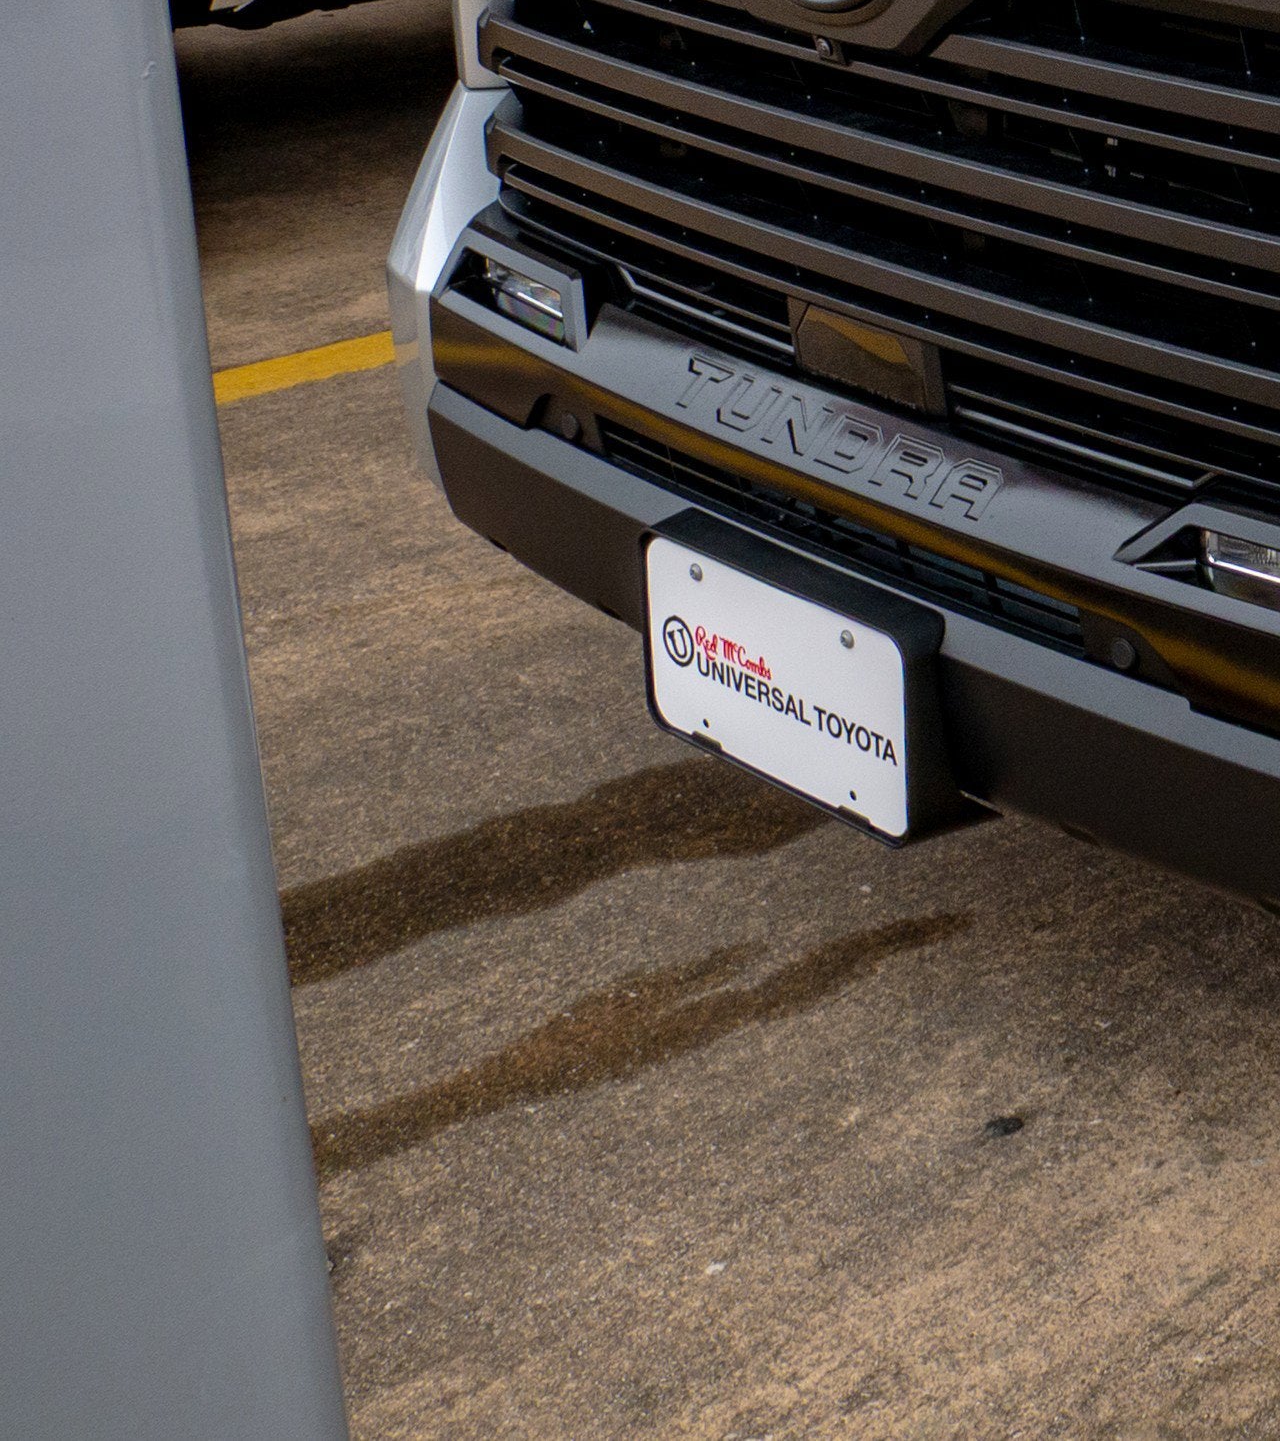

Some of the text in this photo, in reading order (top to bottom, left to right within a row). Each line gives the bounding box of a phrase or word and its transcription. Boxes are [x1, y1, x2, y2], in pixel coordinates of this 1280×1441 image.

[675, 353, 1005, 522] TUNDRA
[694, 625, 772, 681] Red McCombs
[696, 651, 898, 767] UNIVERSAL TOYOTA
